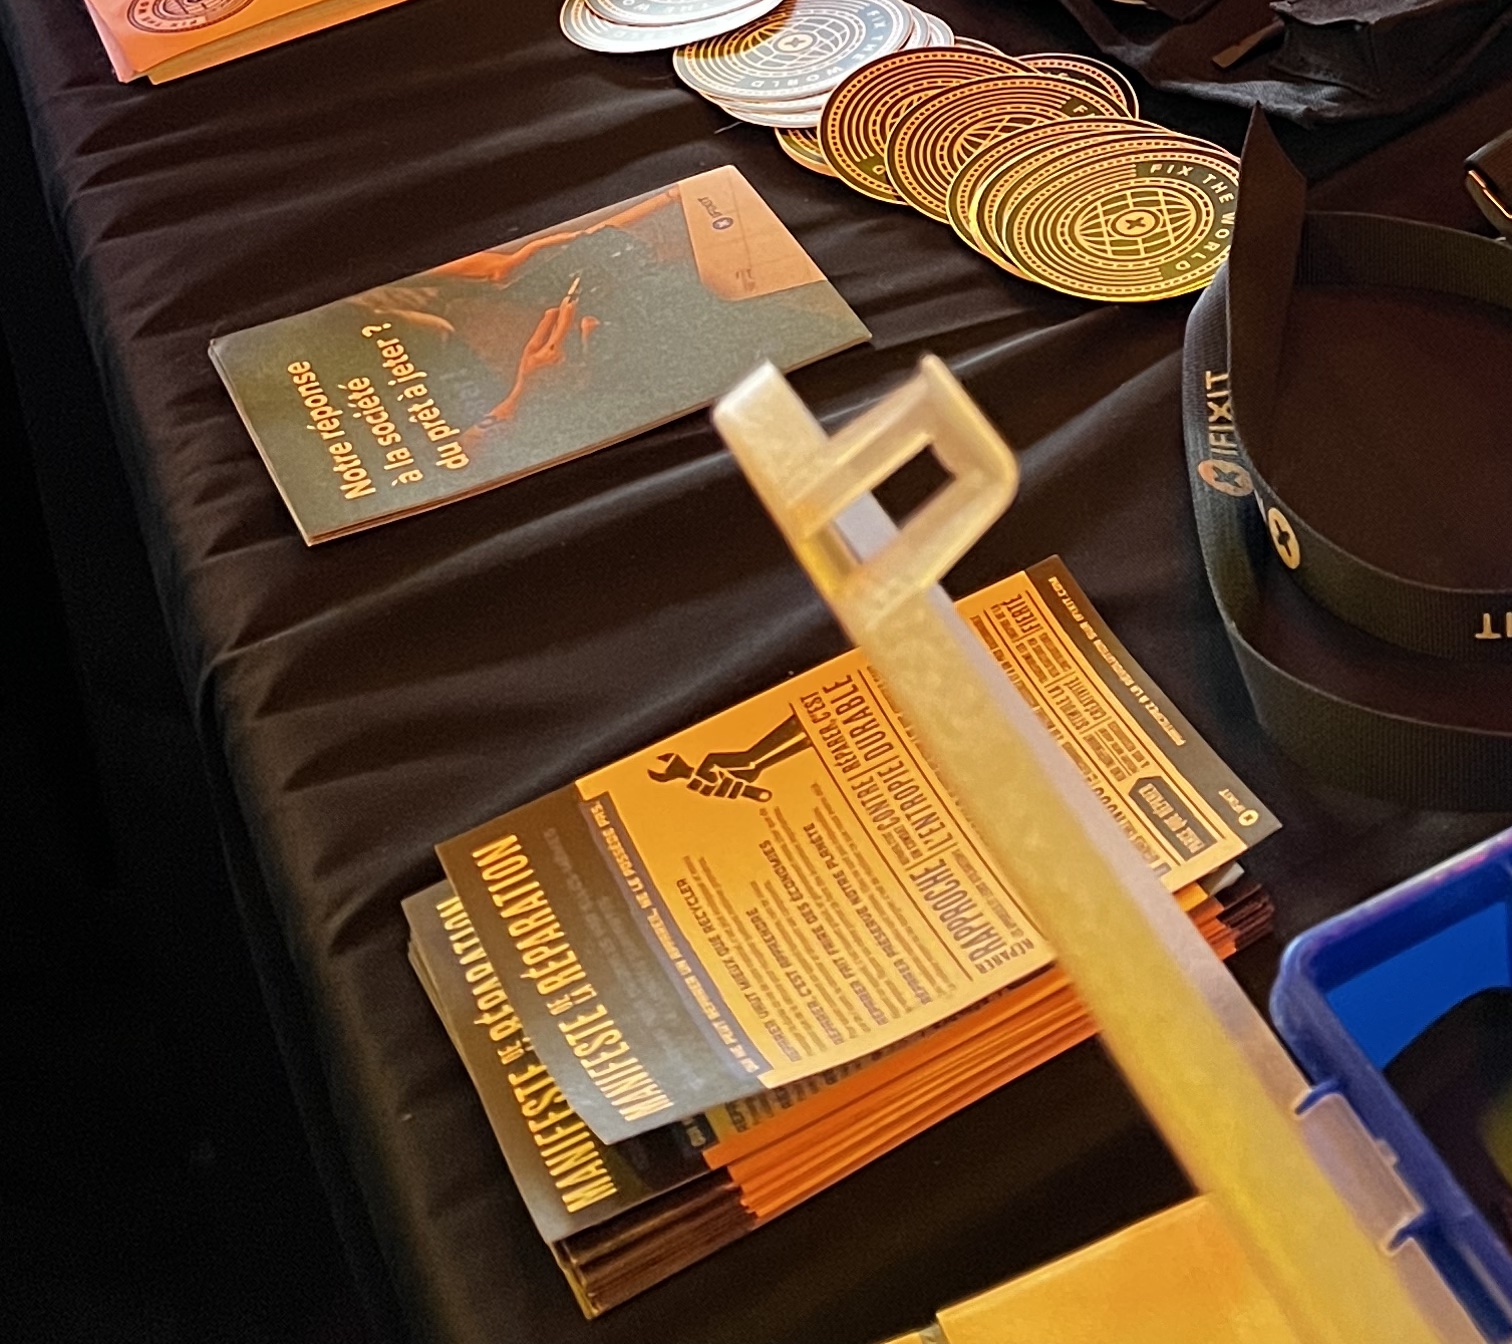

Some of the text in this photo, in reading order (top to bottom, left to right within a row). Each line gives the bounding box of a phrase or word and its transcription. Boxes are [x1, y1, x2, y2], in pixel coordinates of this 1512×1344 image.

[1150, 163, 1235, 270] FIX THE WORLD
[359, 317, 393, 339] ?
[376, 339, 427, 384] jeter
[394, 381, 428, 403] à
[1205, 370, 1237, 456] IFIXIT
[286, 359, 376, 499] Notre réponse
[337, 375, 423, 486] à la société
[407, 397, 460, 441] prêt
[435, 440, 469, 467] du
[1001, 592, 1040, 633] FIERTÉ
[1079, 618, 1099, 641] SUR
[798, 688, 862, 773] RÉPARER, C'EST
[821, 673, 895, 762] DURABLE
[850, 775, 901, 832] CONTRE
[876, 759, 954, 851] L'ENTROPIE
[802, 822, 838, 869] PLANÈTE
[626, 874, 645, 893] LE
[757, 839, 804, 901] ÉCONOMIES
[832, 868, 864, 905] NOTRE
[470, 831, 586, 997] RÉPARATION
[674, 877, 716, 933] RECYCLER
[796, 901, 818, 923] DES
[908, 856, 1007, 962] RAPPROCHE
[706, 932, 731, 957] QUE
[745, 906, 792, 968] APPRENDRE
[811, 923, 840, 955] FAIRE
[973, 937, 1036, 975] RÉPARER
[721, 955, 753, 990] MIEUX
[783, 966, 813, 998] C'EST
[832, 953, 857, 979] FAIT
[545, 993, 573, 1017] DE
[567, 981, 597, 1005] LA
[712, 1018, 738, 1045] PEUT
[556, 1001, 675, 1123] MANIFESTE
[506, 1063, 618, 1214] MANIFESTE
